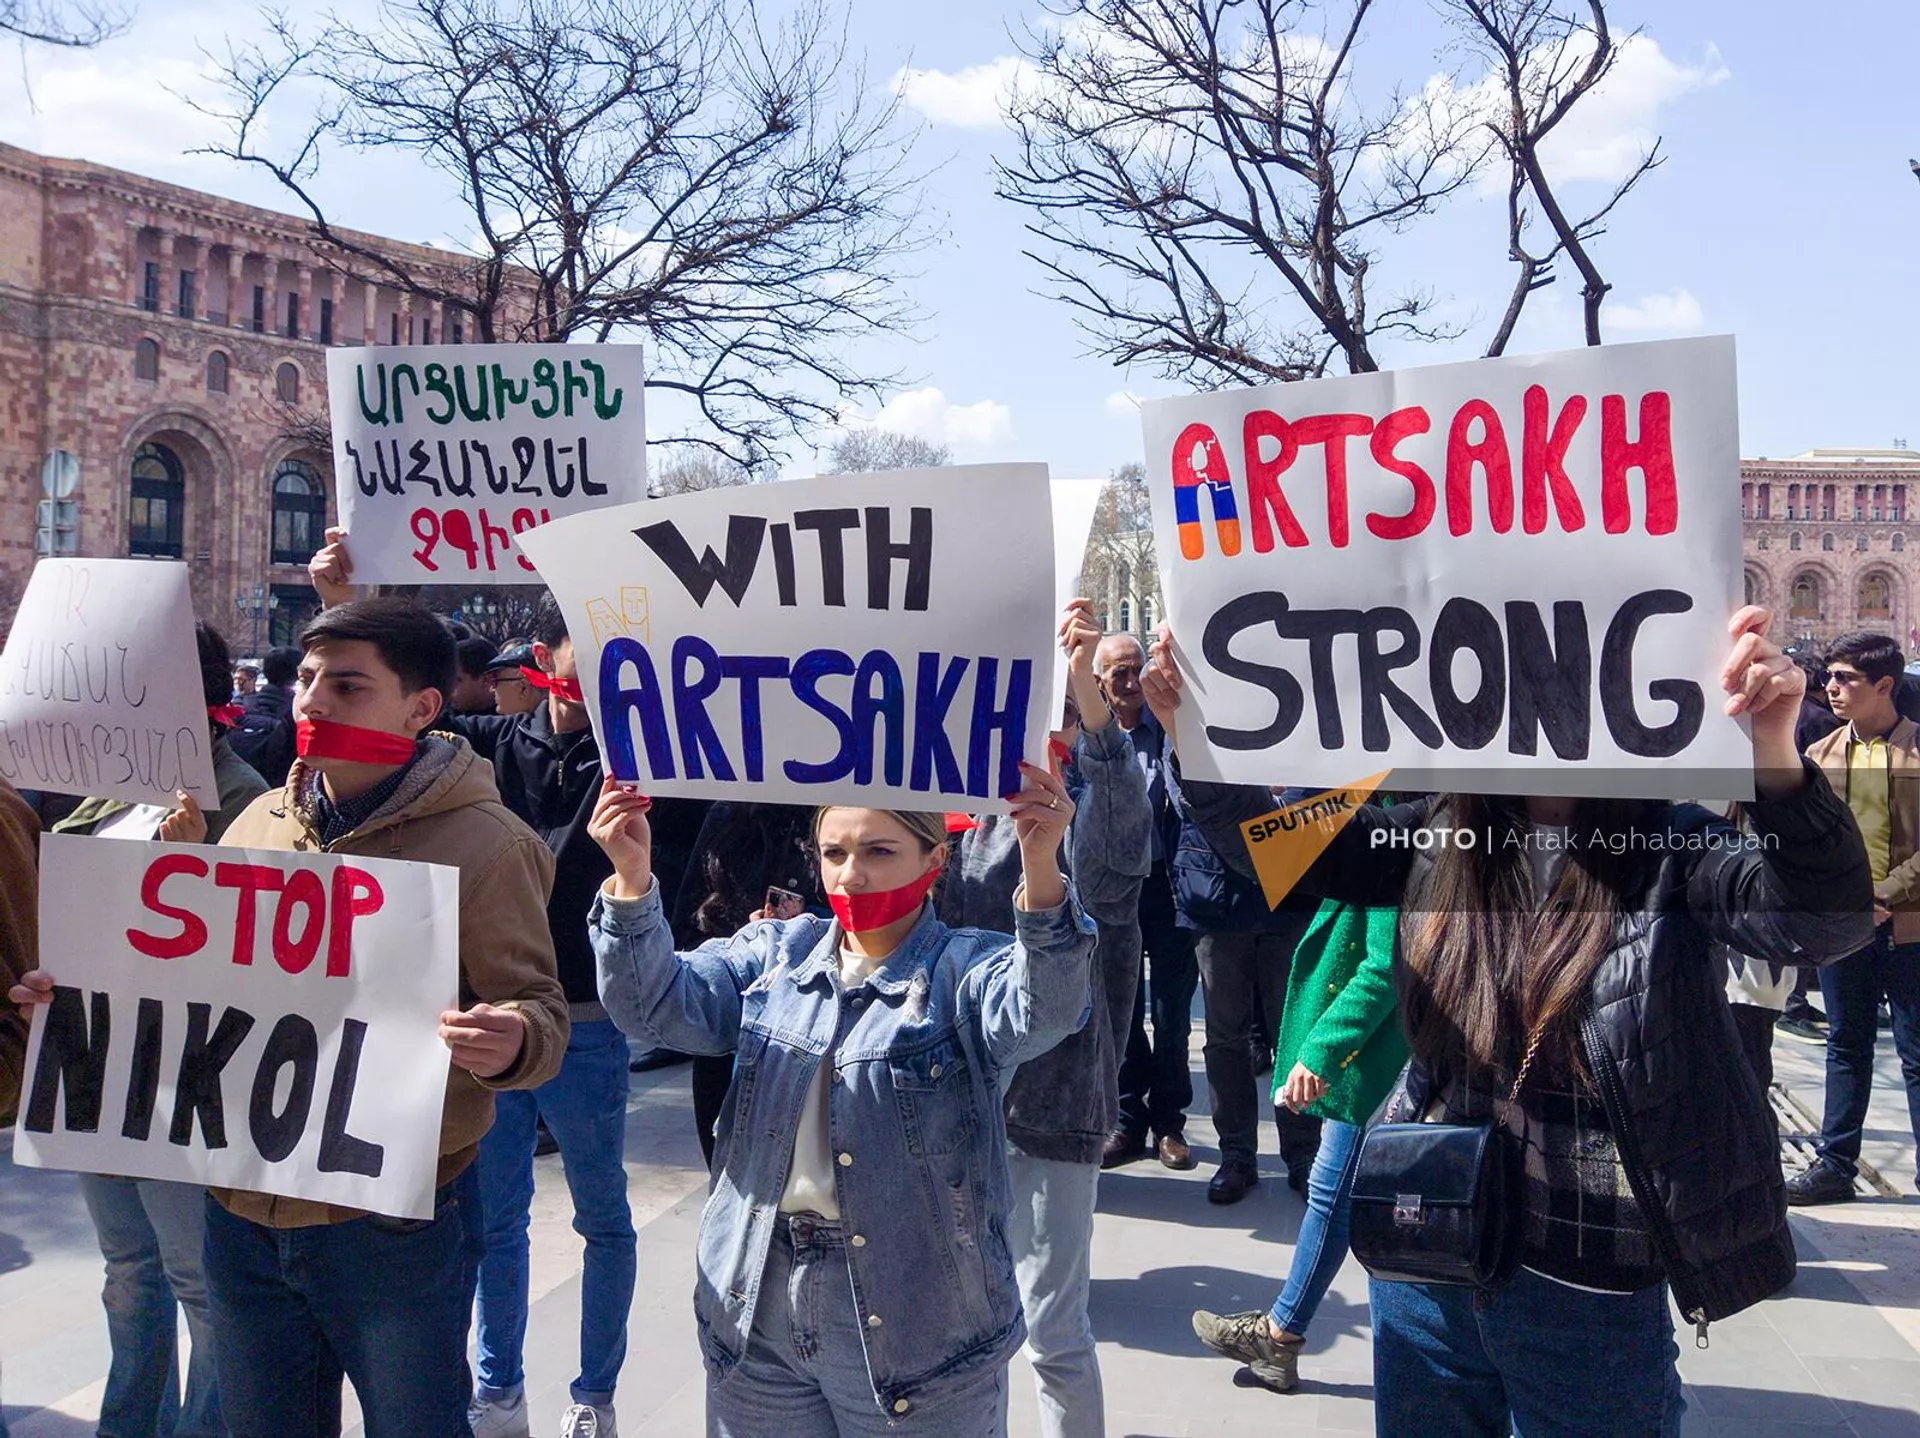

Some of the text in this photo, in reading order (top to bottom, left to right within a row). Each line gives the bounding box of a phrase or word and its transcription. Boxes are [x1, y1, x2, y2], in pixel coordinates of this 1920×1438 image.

[357, 358, 623, 428] ԱՐՑԱԽՑԻՆ
[345, 436, 609, 499] ՆԱՀԱՆՋԵԼ
[1172, 383, 1679, 561] ARTSAKH
[631, 506, 933, 611] WITH
[599, 635, 1032, 797] ARTSAKH
[1201, 589, 1705, 761] STRONG
[126, 853, 385, 978] STOP
[24, 985, 384, 1178] NIKOL
